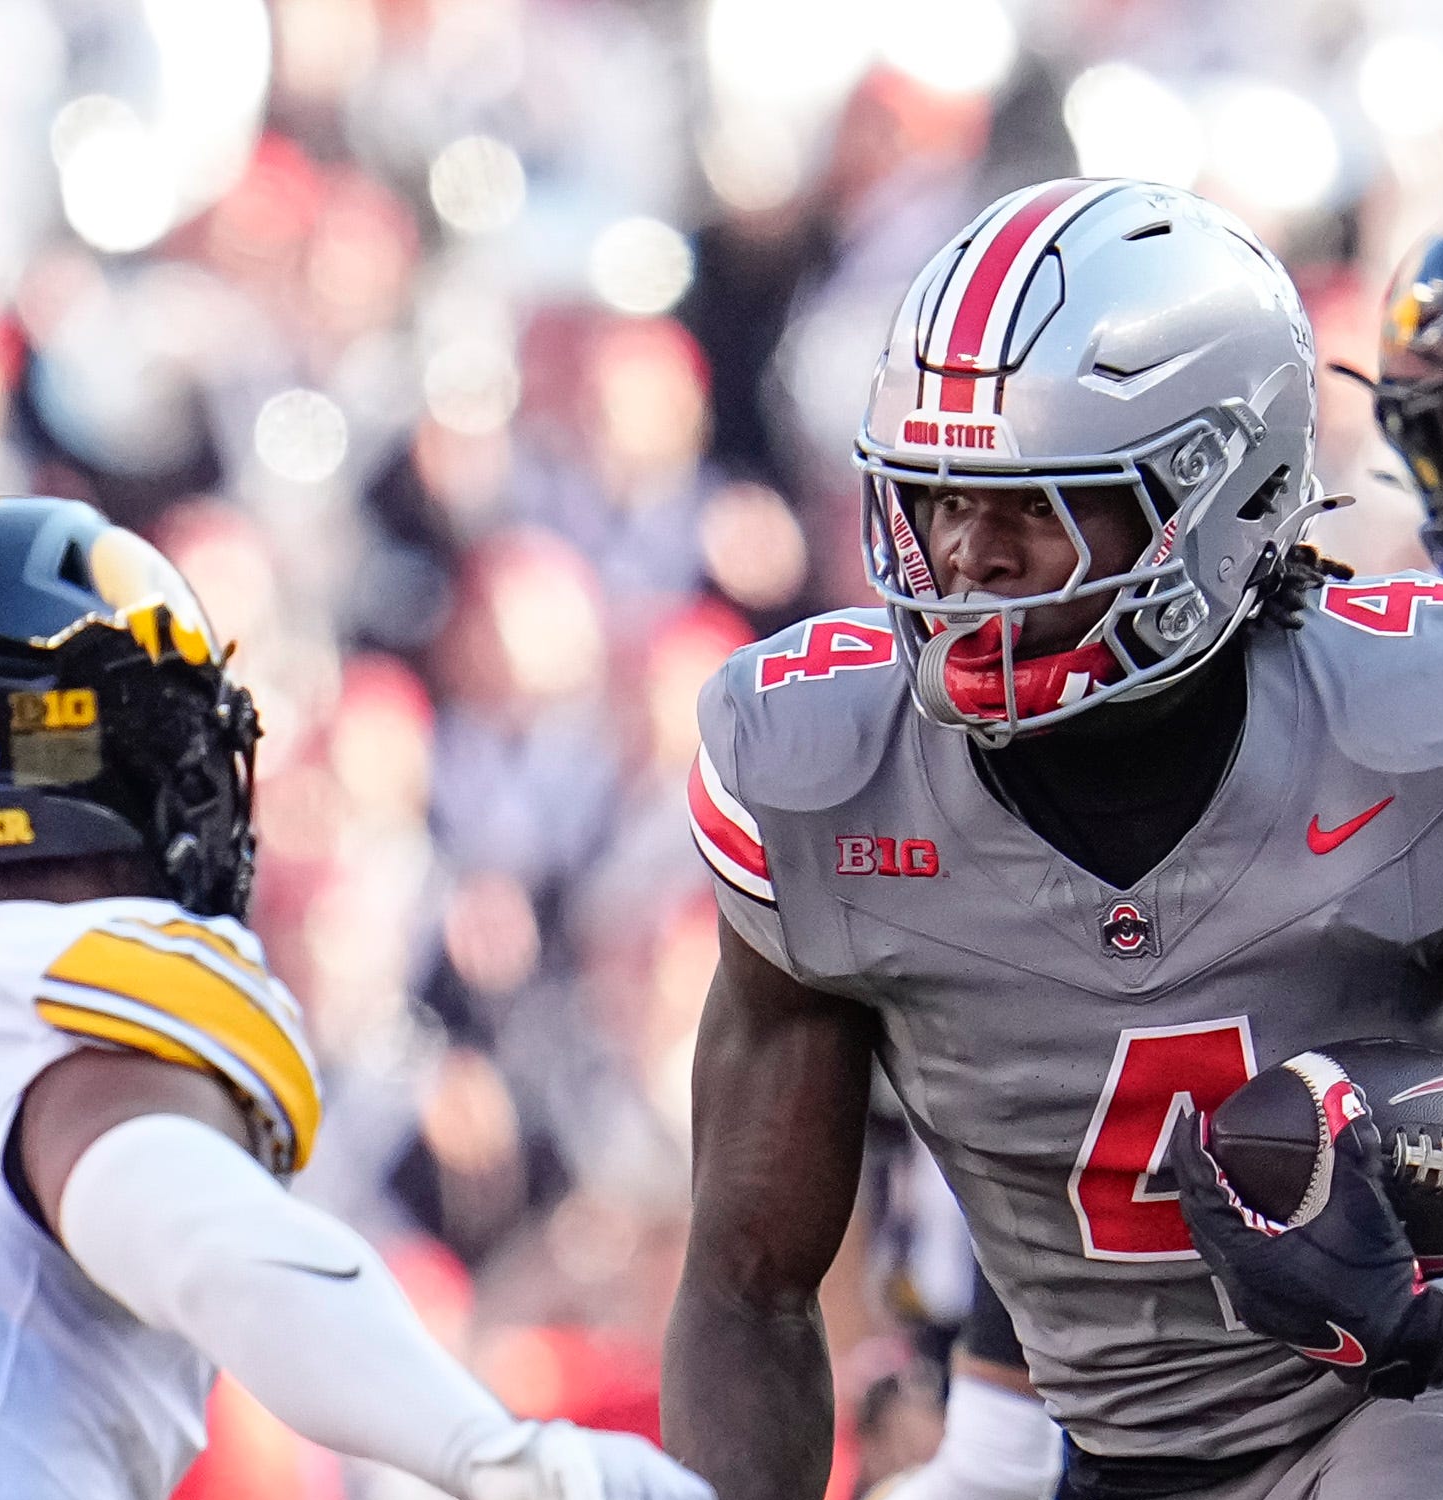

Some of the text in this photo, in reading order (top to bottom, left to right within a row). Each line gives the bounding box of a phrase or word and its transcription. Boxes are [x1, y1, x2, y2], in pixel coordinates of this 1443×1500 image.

[904, 420, 996, 450] OHIO STATE
[893, 512, 934, 595] OHIO STATE
[755, 618, 898, 694] 4
[1067, 1015, 1259, 1332] 4
